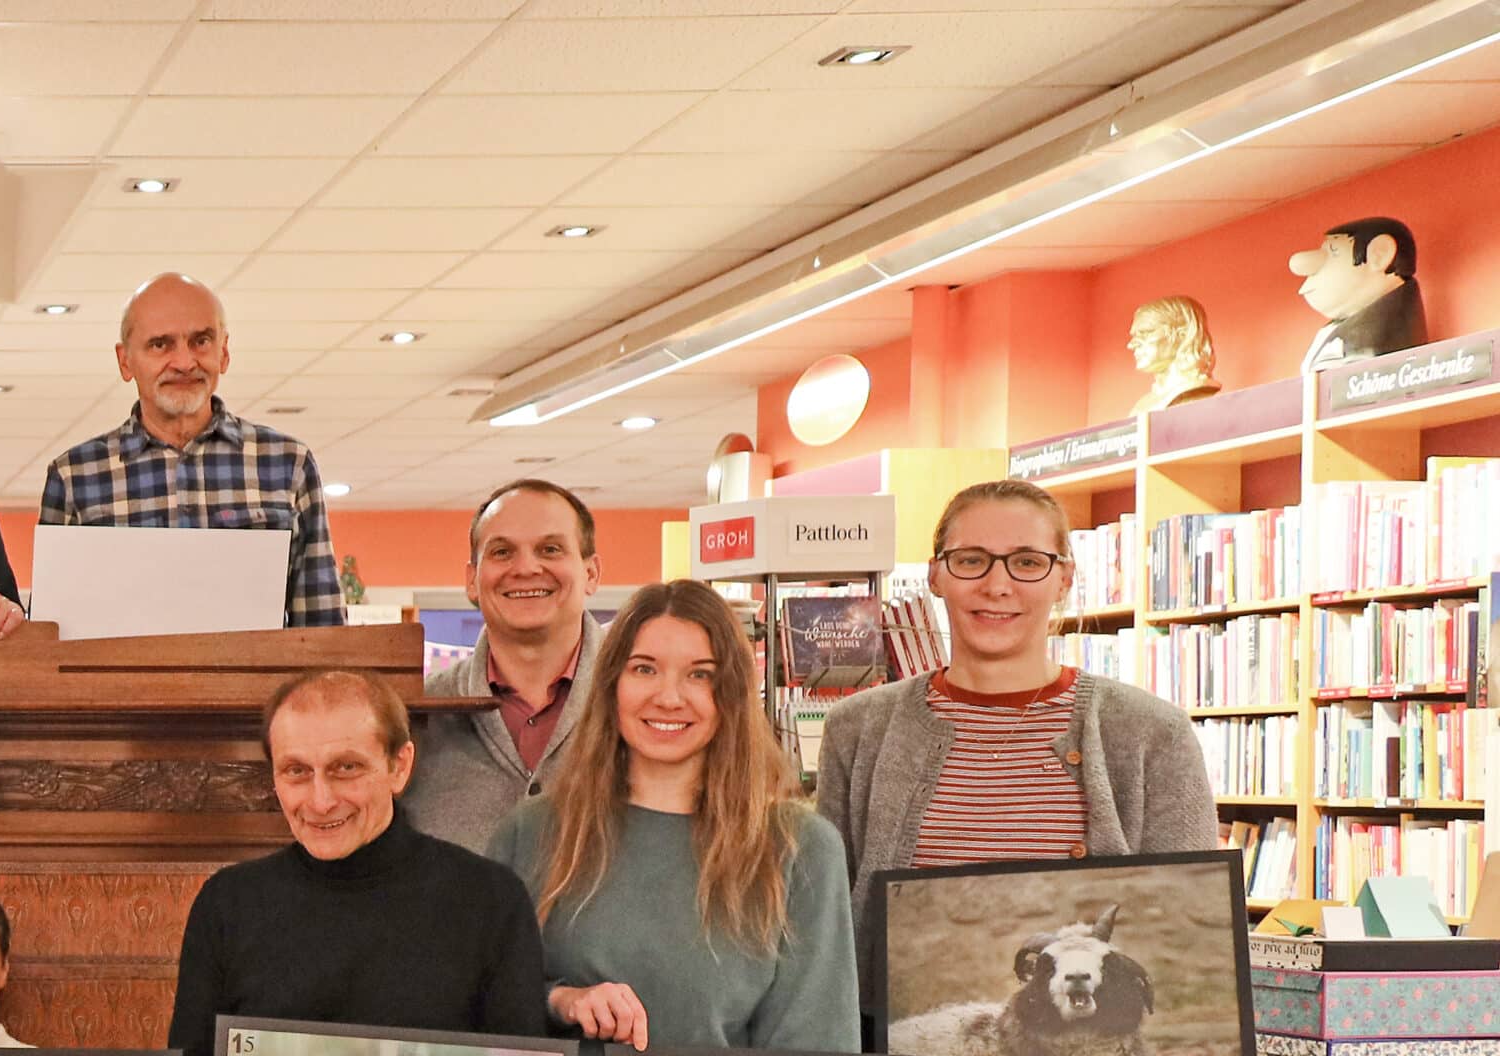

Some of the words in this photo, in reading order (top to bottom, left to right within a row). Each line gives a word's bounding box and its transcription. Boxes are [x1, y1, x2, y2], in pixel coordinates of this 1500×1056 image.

[1347, 371, 1396, 399] Schöne
[1398, 349, 1474, 388] Geschenke
[706, 530, 748, 549] GROH
[796, 523, 868, 541] Pattloch
[232, 1033, 255, 1053] 15
